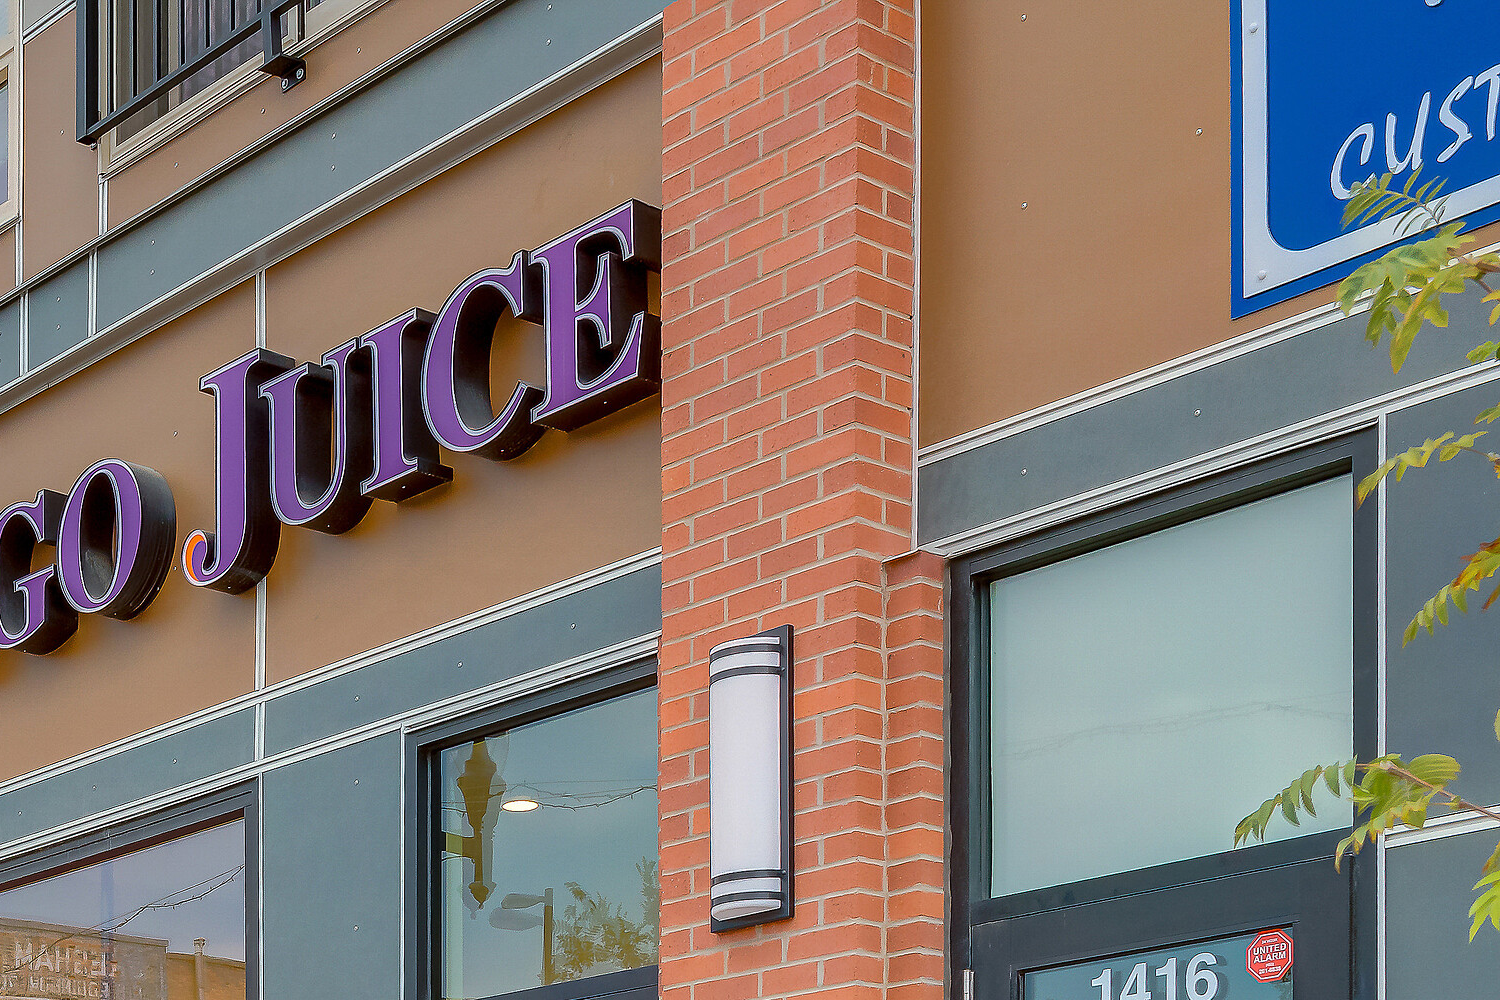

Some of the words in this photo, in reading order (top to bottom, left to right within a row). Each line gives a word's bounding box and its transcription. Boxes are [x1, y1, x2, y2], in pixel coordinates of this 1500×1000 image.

[1331, 63, 1500, 200] CUST
[182, 198, 659, 593] JUICE
[1253, 943, 1287, 956] UNITED
[1253, 951, 1287, 964] ALARM
